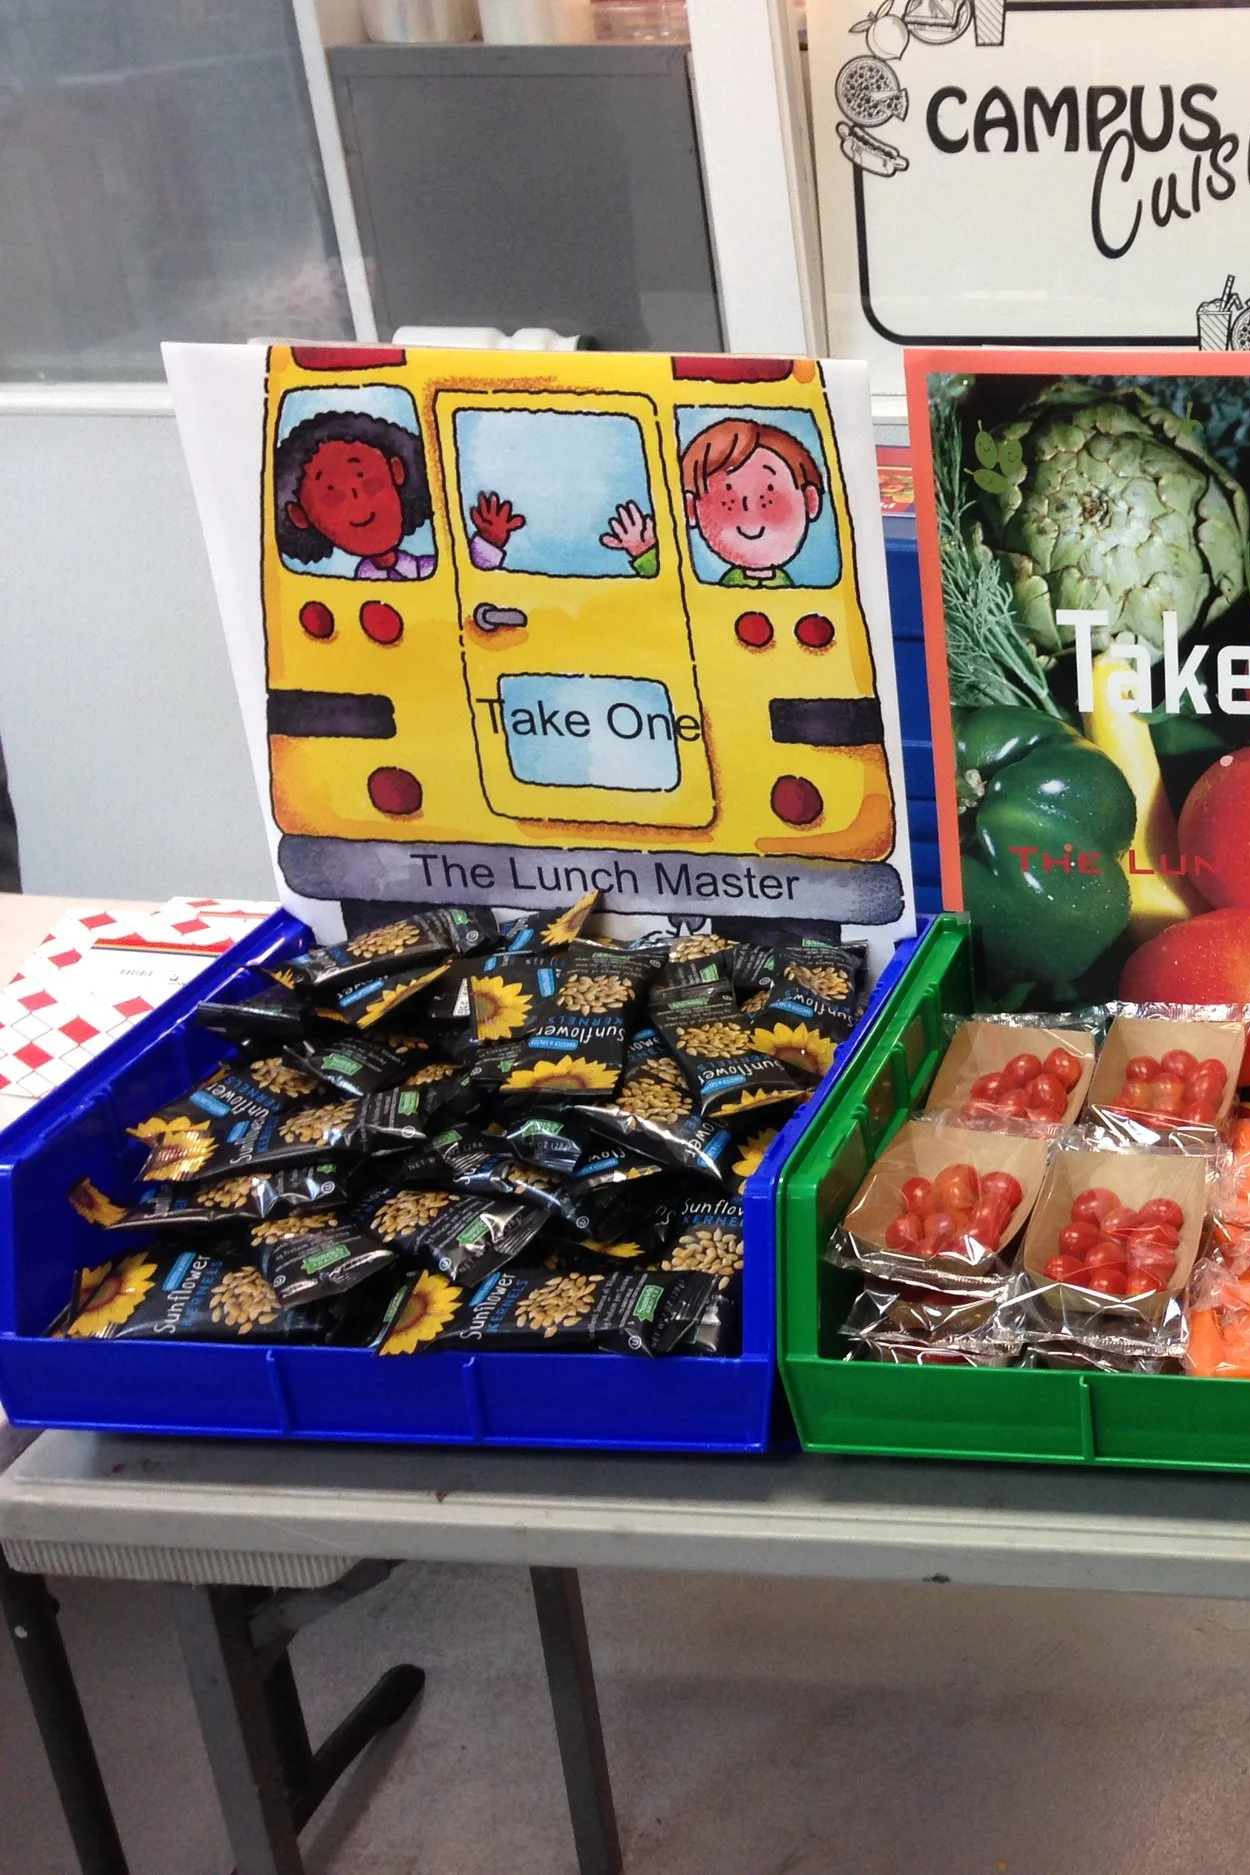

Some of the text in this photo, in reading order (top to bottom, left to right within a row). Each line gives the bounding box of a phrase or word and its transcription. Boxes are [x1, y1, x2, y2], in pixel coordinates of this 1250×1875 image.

[926, 83, 1221, 153] CAMPUS
[476, 698, 702, 742] Take One
[410, 852, 800, 901] The Lunch Master
[537, 1025, 626, 1044] Sunflower
[547, 1016, 624, 1026] KERNELS
[206, 1083, 270, 1118] unflower
[153, 1255, 211, 1334] Sunflower
[460, 1273, 516, 1340] Sunflower
